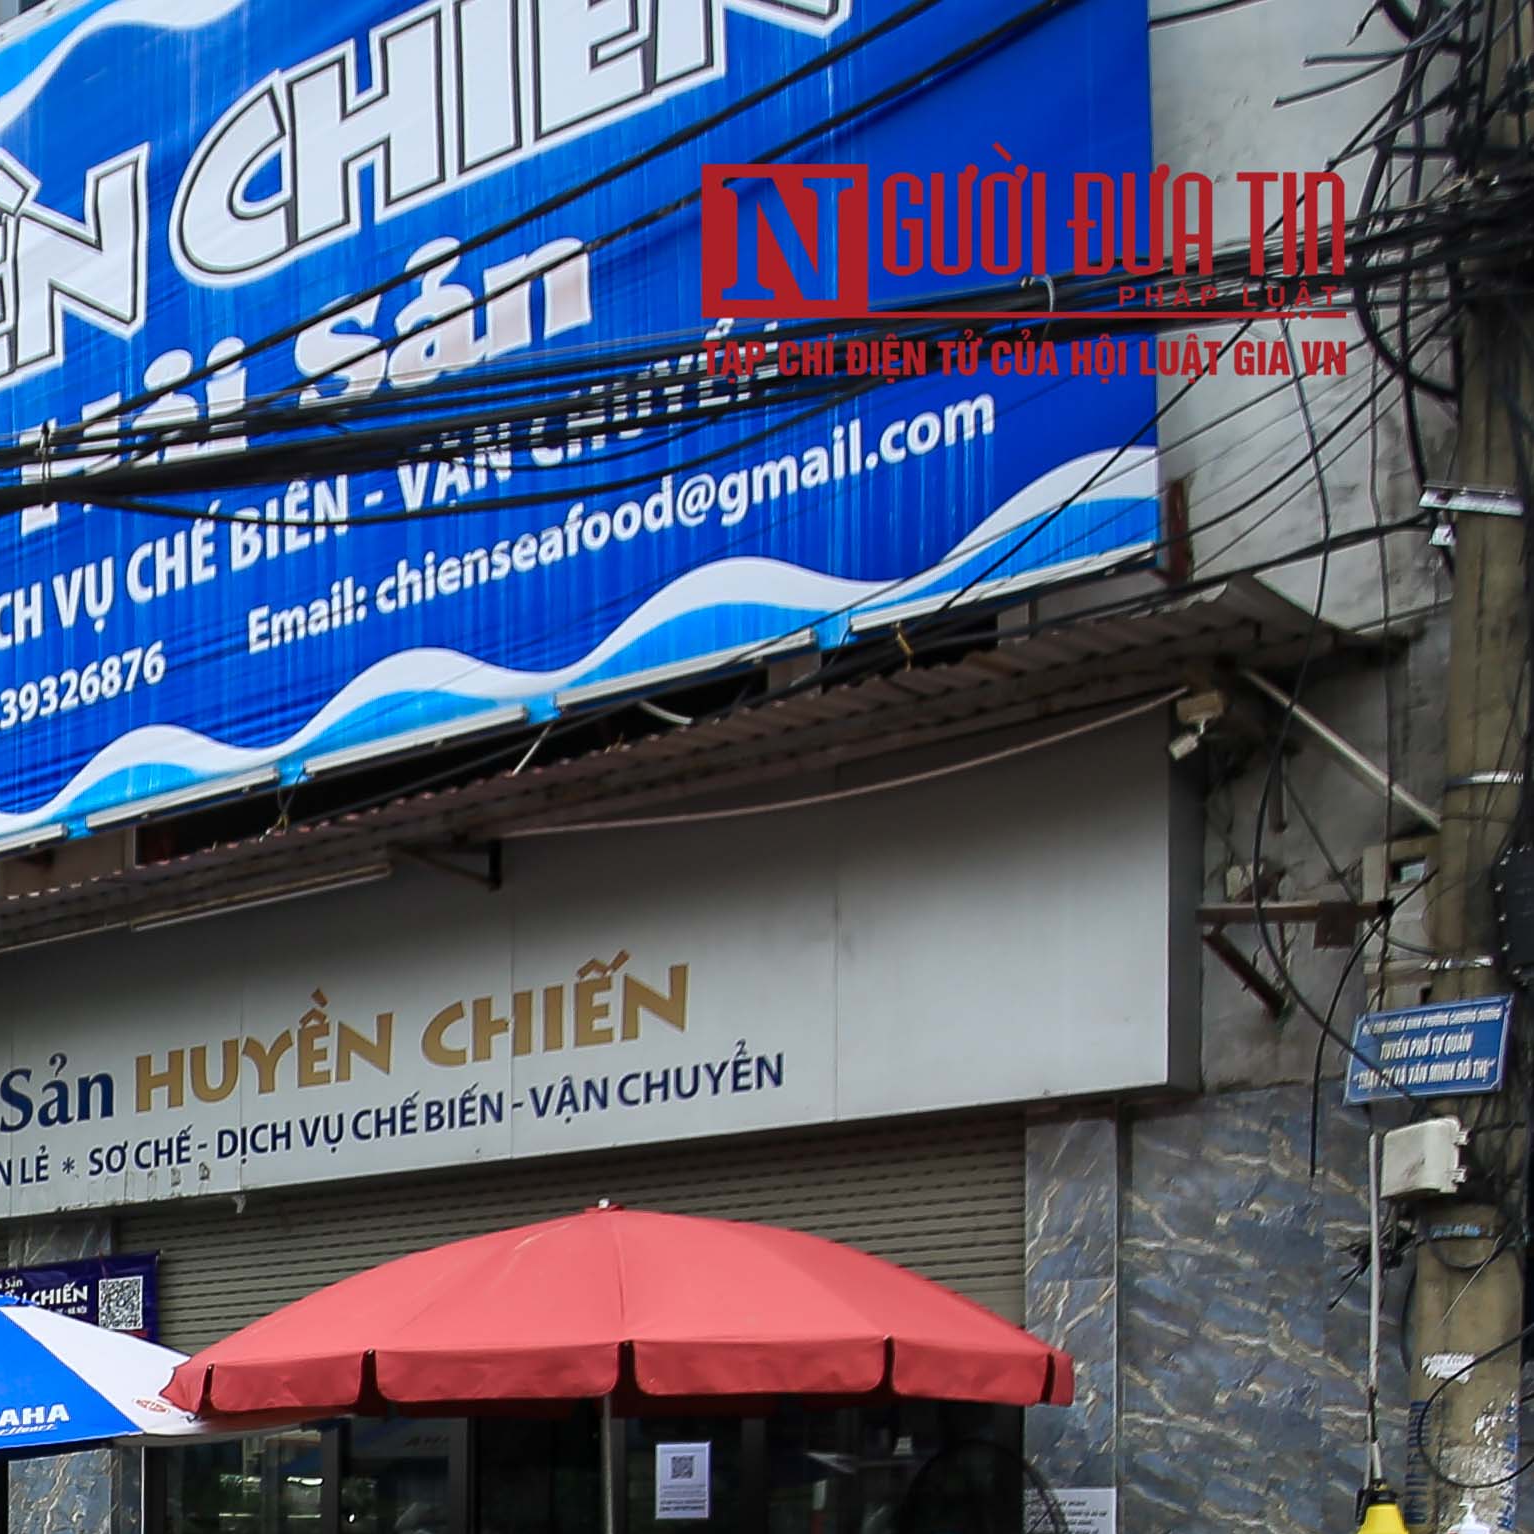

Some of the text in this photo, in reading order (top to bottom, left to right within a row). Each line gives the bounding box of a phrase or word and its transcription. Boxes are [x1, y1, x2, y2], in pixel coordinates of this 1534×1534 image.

[53, 556, 115, 633] VỤ
[126, 500, 222, 603] CHẾ
[247, 391, 995, 654] Email: chienseafood@gmail.com
[0, 1053, 115, 1133] Sản
[134, 950, 689, 1114] HUYỀN CHIẾN
[20, 1143, 50, 1184] LẺ
[88, 1142, 130, 1177] SƠ
[134, 1123, 195, 1169] CHẾ
[216, 1121, 291, 1166] DỊCH
[298, 1112, 344, 1154] VỤ
[351, 1090, 419, 1141] CHẾ
[424, 1081, 504, 1132] BIẾN
[531, 1075, 610, 1124] VẬN
[617, 1038, 786, 1107] CHUYỂN
[31, 1280, 89, 1306] CHIẾN
